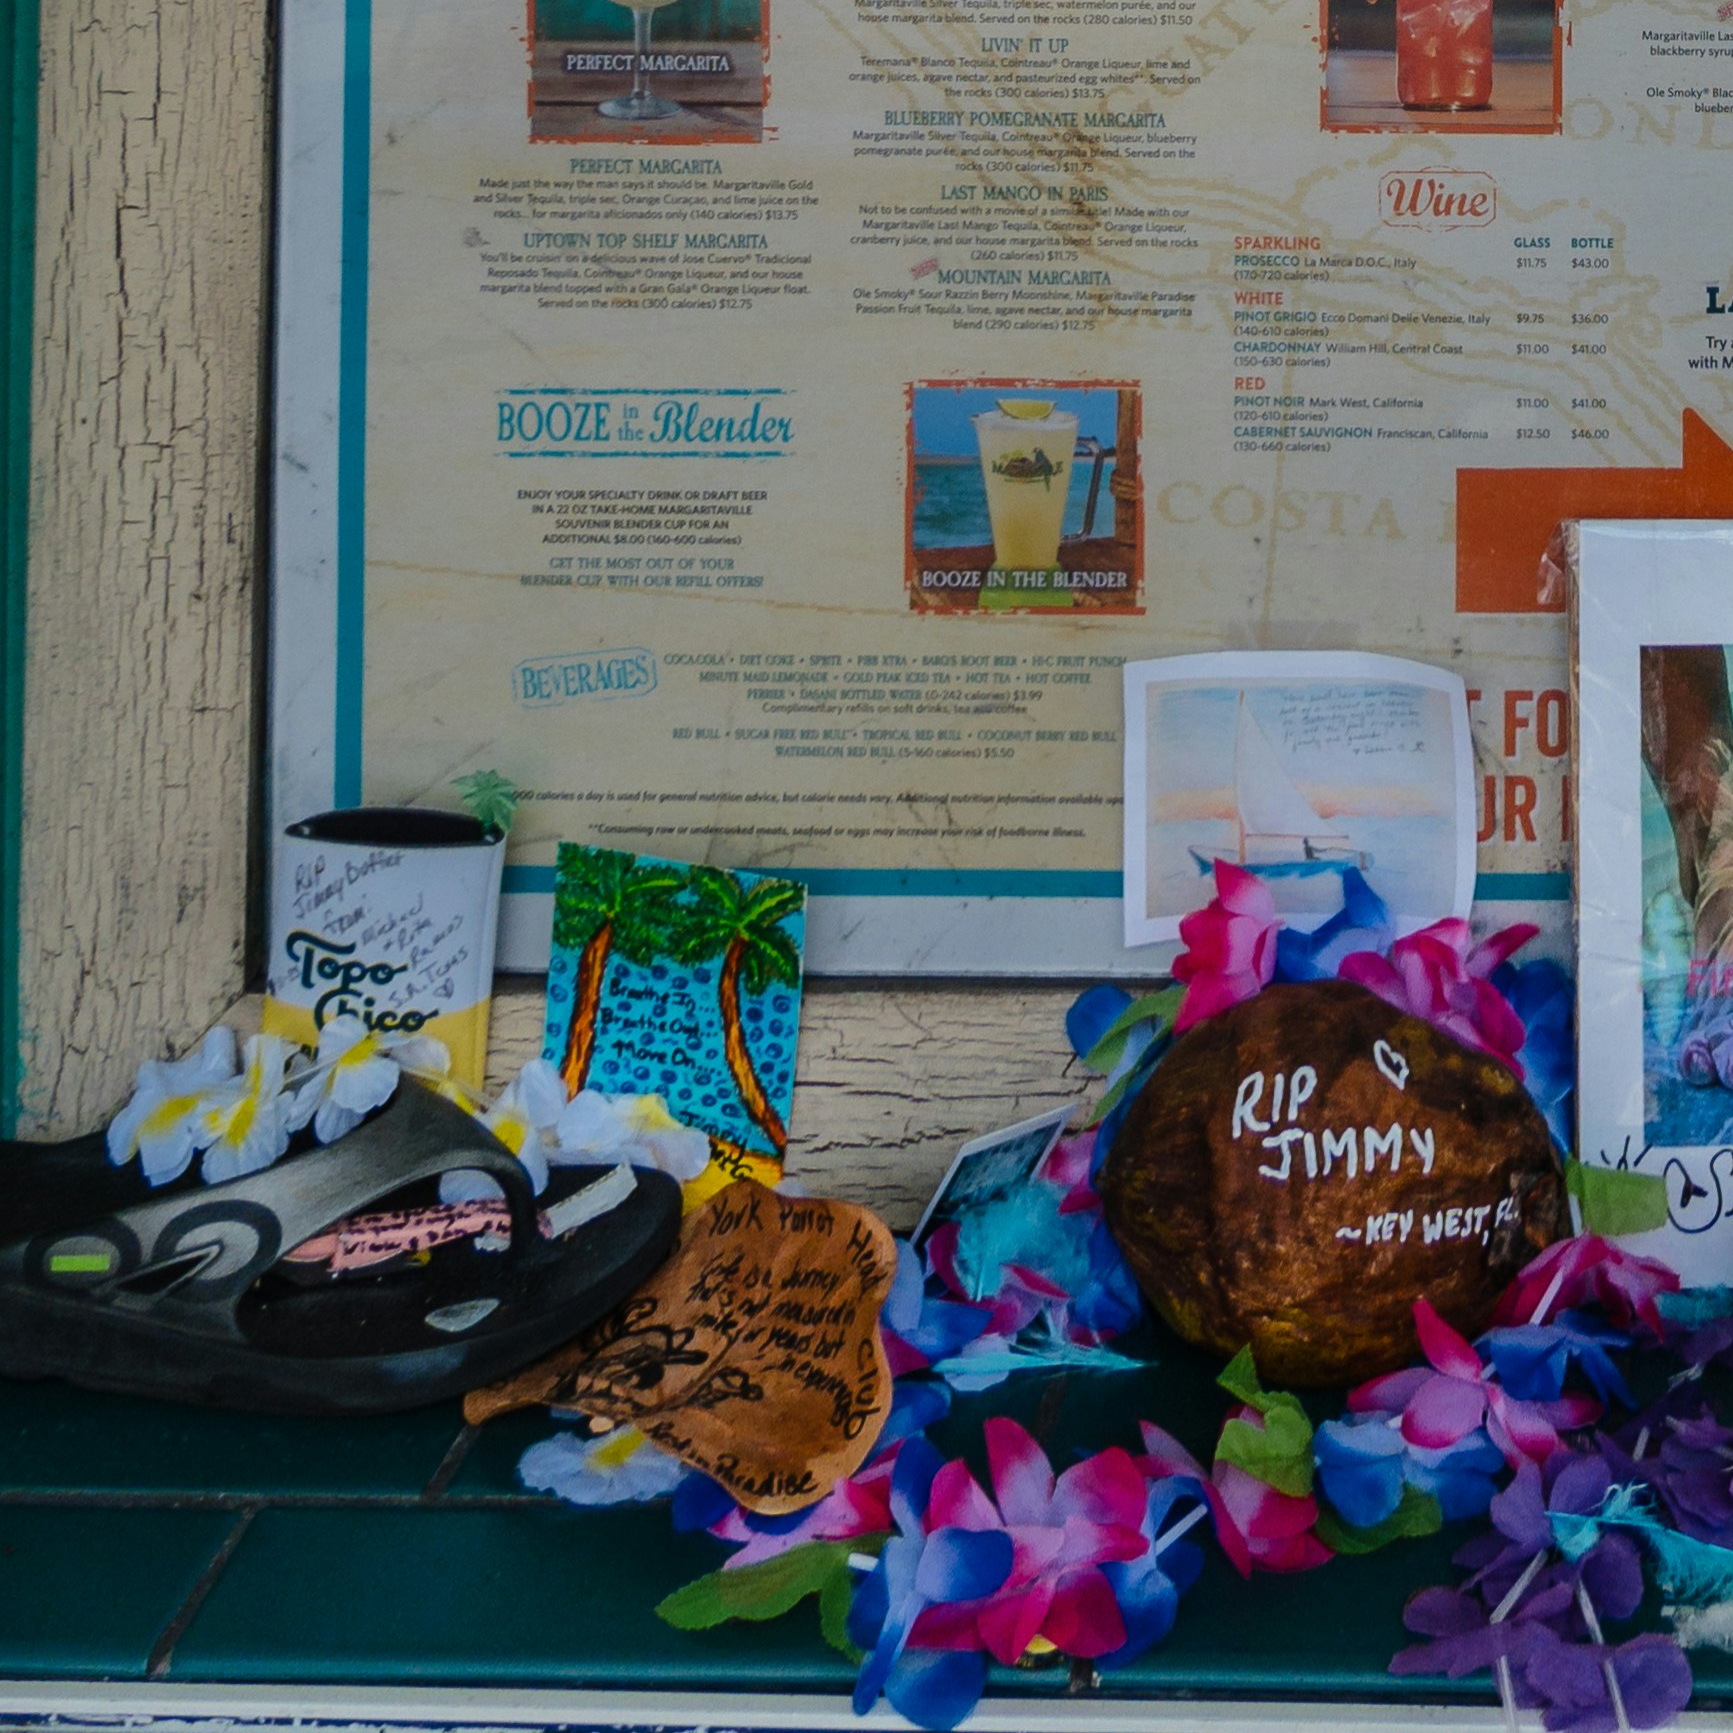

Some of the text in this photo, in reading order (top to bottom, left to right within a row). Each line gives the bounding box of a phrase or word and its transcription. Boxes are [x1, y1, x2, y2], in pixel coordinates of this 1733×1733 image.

[567, 55, 729, 74] PERFECT MARGARITA
[1387, 174, 1490, 217] Wine
[1235, 236, 1321, 250] SPARKLING
[1514, 237, 1614, 249] GLASS BOTTLE
[1235, 291, 1283, 305] WHITE
[1688, 356, 1718, 369] with
[1705, 336, 1727, 352] Try
[1235, 377, 1265, 390] RED
[498, 401, 794, 443] BOOZE in the Blender
[922, 571, 1127, 588] BOOZE IN THE BLENDER
[519, 660, 651, 699] BEVERAGES
[294, 855, 326, 894] RIP
[285, 928, 409, 990] Topo
[313, 986, 440, 1033] Chico
[609, 977, 670, 1005] Breathe
[601, 1007, 667, 1034] Breathe
[611, 1039, 667, 1065] Move
[1232, 1065, 1317, 1139] RIP
[1258, 1122, 1436, 1180] JIMMY
[709, 1200, 764, 1238] York
[778, 1203, 836, 1237] Parrot
[1422, 1205, 1490, 1246] WEST,
[846, 1221, 890, 1298] Head
[842, 1337, 882, 1440] Club
[715, 1453, 818, 1496] Paradise
